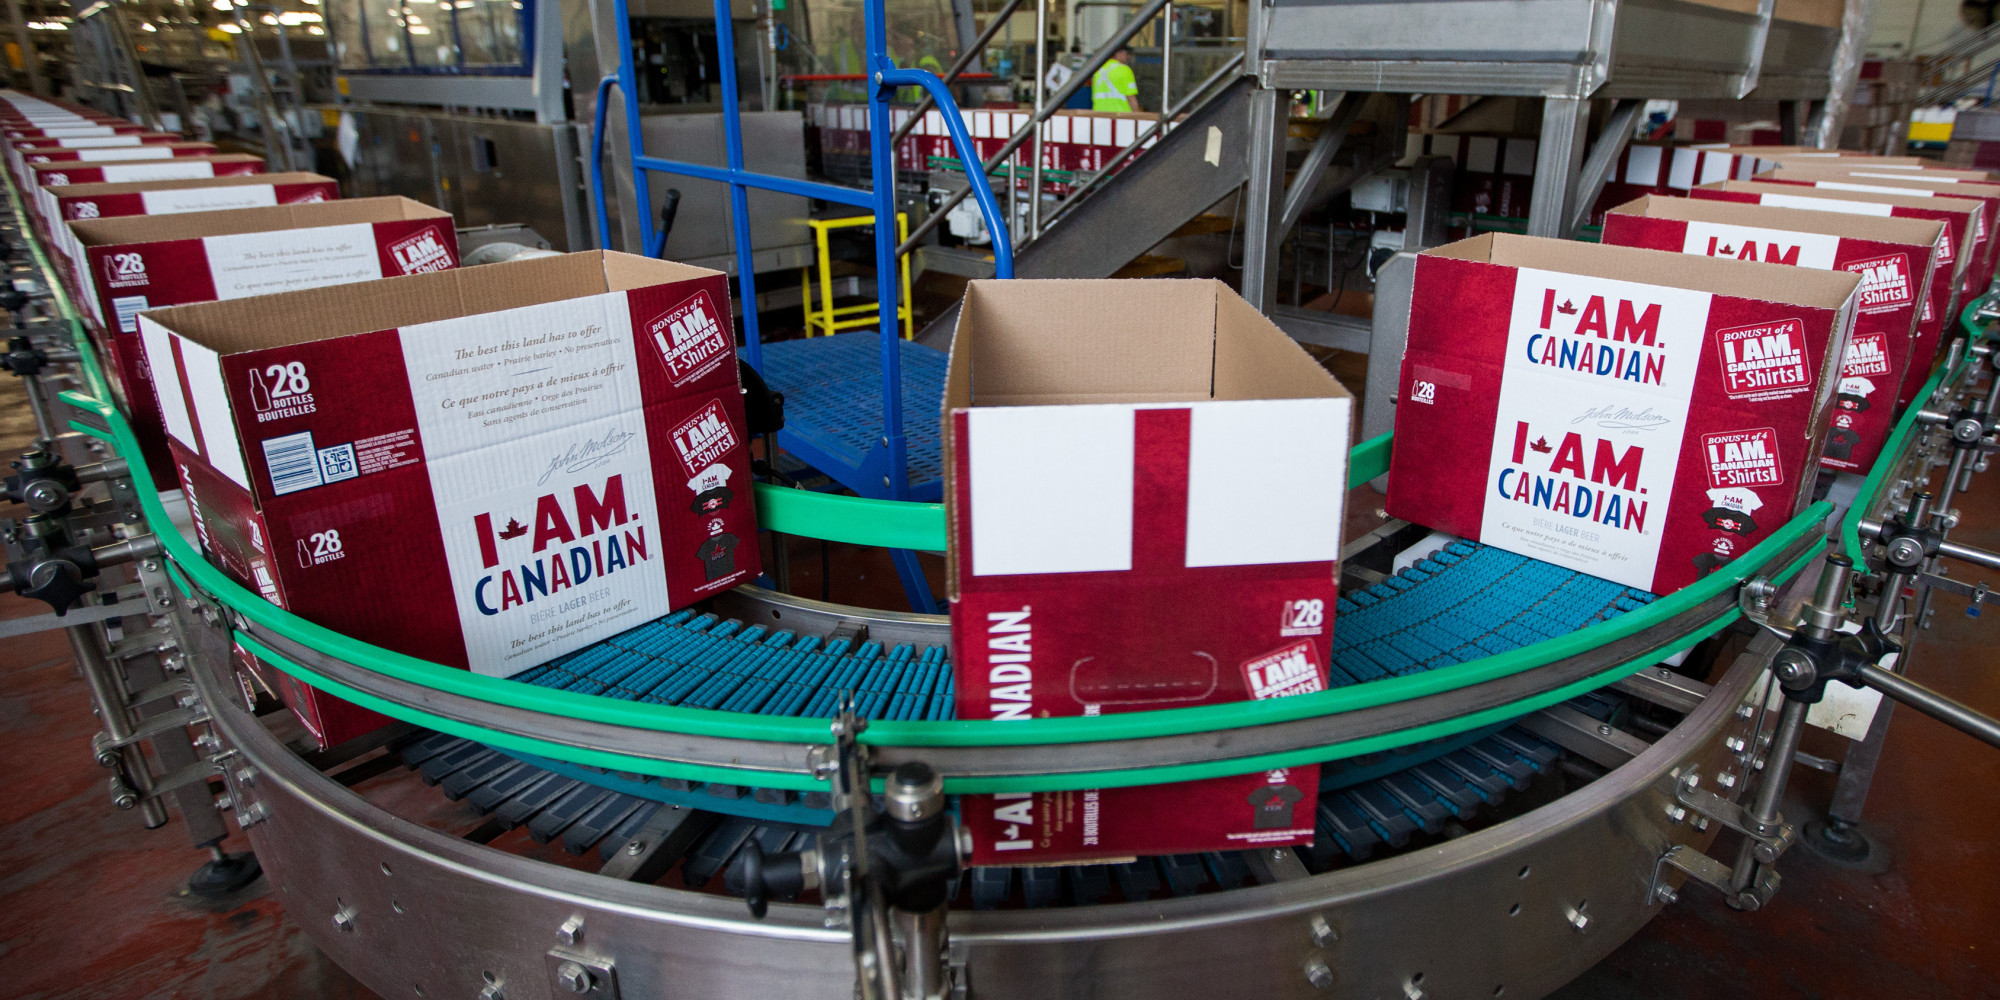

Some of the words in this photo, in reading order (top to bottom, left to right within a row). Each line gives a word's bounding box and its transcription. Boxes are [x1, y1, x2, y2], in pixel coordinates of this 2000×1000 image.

[114, 252, 146, 275] 28
[394, 250, 408, 267] I
[1862, 264, 1906, 286] AM.
[690, 299, 698, 311] of
[698, 296, 704, 305] 4
[1540, 288, 1557, 330] I
[1574, 294, 1666, 349] AM.
[455, 349, 474, 361] The
[477, 345, 498, 357] best
[501, 340, 521, 353] this
[523, 333, 546, 348] land
[548, 331, 566, 343] has
[568, 331, 578, 339] to
[579, 324, 602, 338] offer
[654, 331, 671, 354] I
[669, 306, 716, 347] AM.
[664, 324, 719, 363] CANADIAN
[1774, 324, 1787, 336] of
[1786, 324, 1794, 332] 4
[426, 367, 469, 382] Canadian
[472, 362, 495, 374] water
[503, 355, 531, 367] Prairie
[533, 349, 557, 361] barley
[563, 346, 575, 355] No
[576, 336, 622, 353] preservatives
[1527, 334, 1666, 386] CANADIAN
[1724, 342, 1737, 364] I
[1743, 333, 1800, 362] AM.
[1727, 355, 1802, 373] CANADIAN
[266, 361, 311, 399] 28
[441, 398, 456, 410] Ce
[459, 395, 479, 410] que
[482, 389, 510, 402] notre
[512, 383, 535, 398] pays
[546, 376, 558, 387] de
[560, 372, 590, 385] mieux
[592, 368, 599, 377] à
[600, 363, 625, 378] offrir
[1418, 381, 1436, 400] 28
[257, 403, 317, 423] BOUTEILLES
[273, 393, 315, 410] BOTTLES
[467, 410, 485, 420] Eau
[486, 399, 533, 415] canadienne
[541, 393, 559, 404] Orge
[561, 389, 574, 400] des
[574, 383, 604, 396] Prairies
[482, 419, 502, 428] Sans
[503, 412, 528, 425] agents
[530, 408, 540, 417] de
[541, 398, 588, 415] conservation
[705, 407, 712, 417] of
[712, 404, 717, 412] 4
[675, 436, 689, 456] I
[688, 413, 727, 449] AM.
[683, 425, 730, 463] CANADIAN
[1751, 433, 1761, 441] of
[1761, 432, 1768, 440] 4
[1512, 420, 1530, 465] I
[1550, 431, 1648, 495] AM.
[1708, 444, 1720, 464] I
[1725, 440, 1774, 463] AM.
[1711, 459, 1775, 472] CANADIAN
[1498, 468, 1648, 535] CANADIAN
[474, 512, 500, 570] I
[533, 473, 639, 554] AM.
[1533, 517, 1554, 531] BIÈRE
[1555, 523, 1579, 538] LAGER
[1580, 530, 1600, 543] BEER
[310, 529, 343, 558] 28
[1501, 521, 1511, 530] Ce
[1511, 526, 1525, 535] que
[1525, 528, 1543, 539] notre
[1544, 534, 1561, 544] pays
[1568, 540, 1577, 548] de
[1578, 544, 1601, 555] mieux
[1608, 551, 1629, 562] offrir
[315, 551, 346, 566] BOTTLES
[475, 525, 648, 616] CANADIAN
[530, 606, 557, 625] BIÈRE
[559, 596, 588, 614] LAGER
[589, 587, 611, 603] BEER
[1292, 599, 1325, 628] 28
[511, 640, 526, 650] The
[528, 632, 546, 643] best
[548, 626, 564, 637] this
[566, 614, 585, 629] land
[587, 610, 602, 620] has
[613, 599, 632, 612] offer
[1249, 671, 1264, 692] I
[1265, 653, 1317, 686] AM.
[1084, 802, 1100, 837] BOUTEILLES
[995, 840, 1034, 851] I
[1084, 837, 1099, 846] 28
